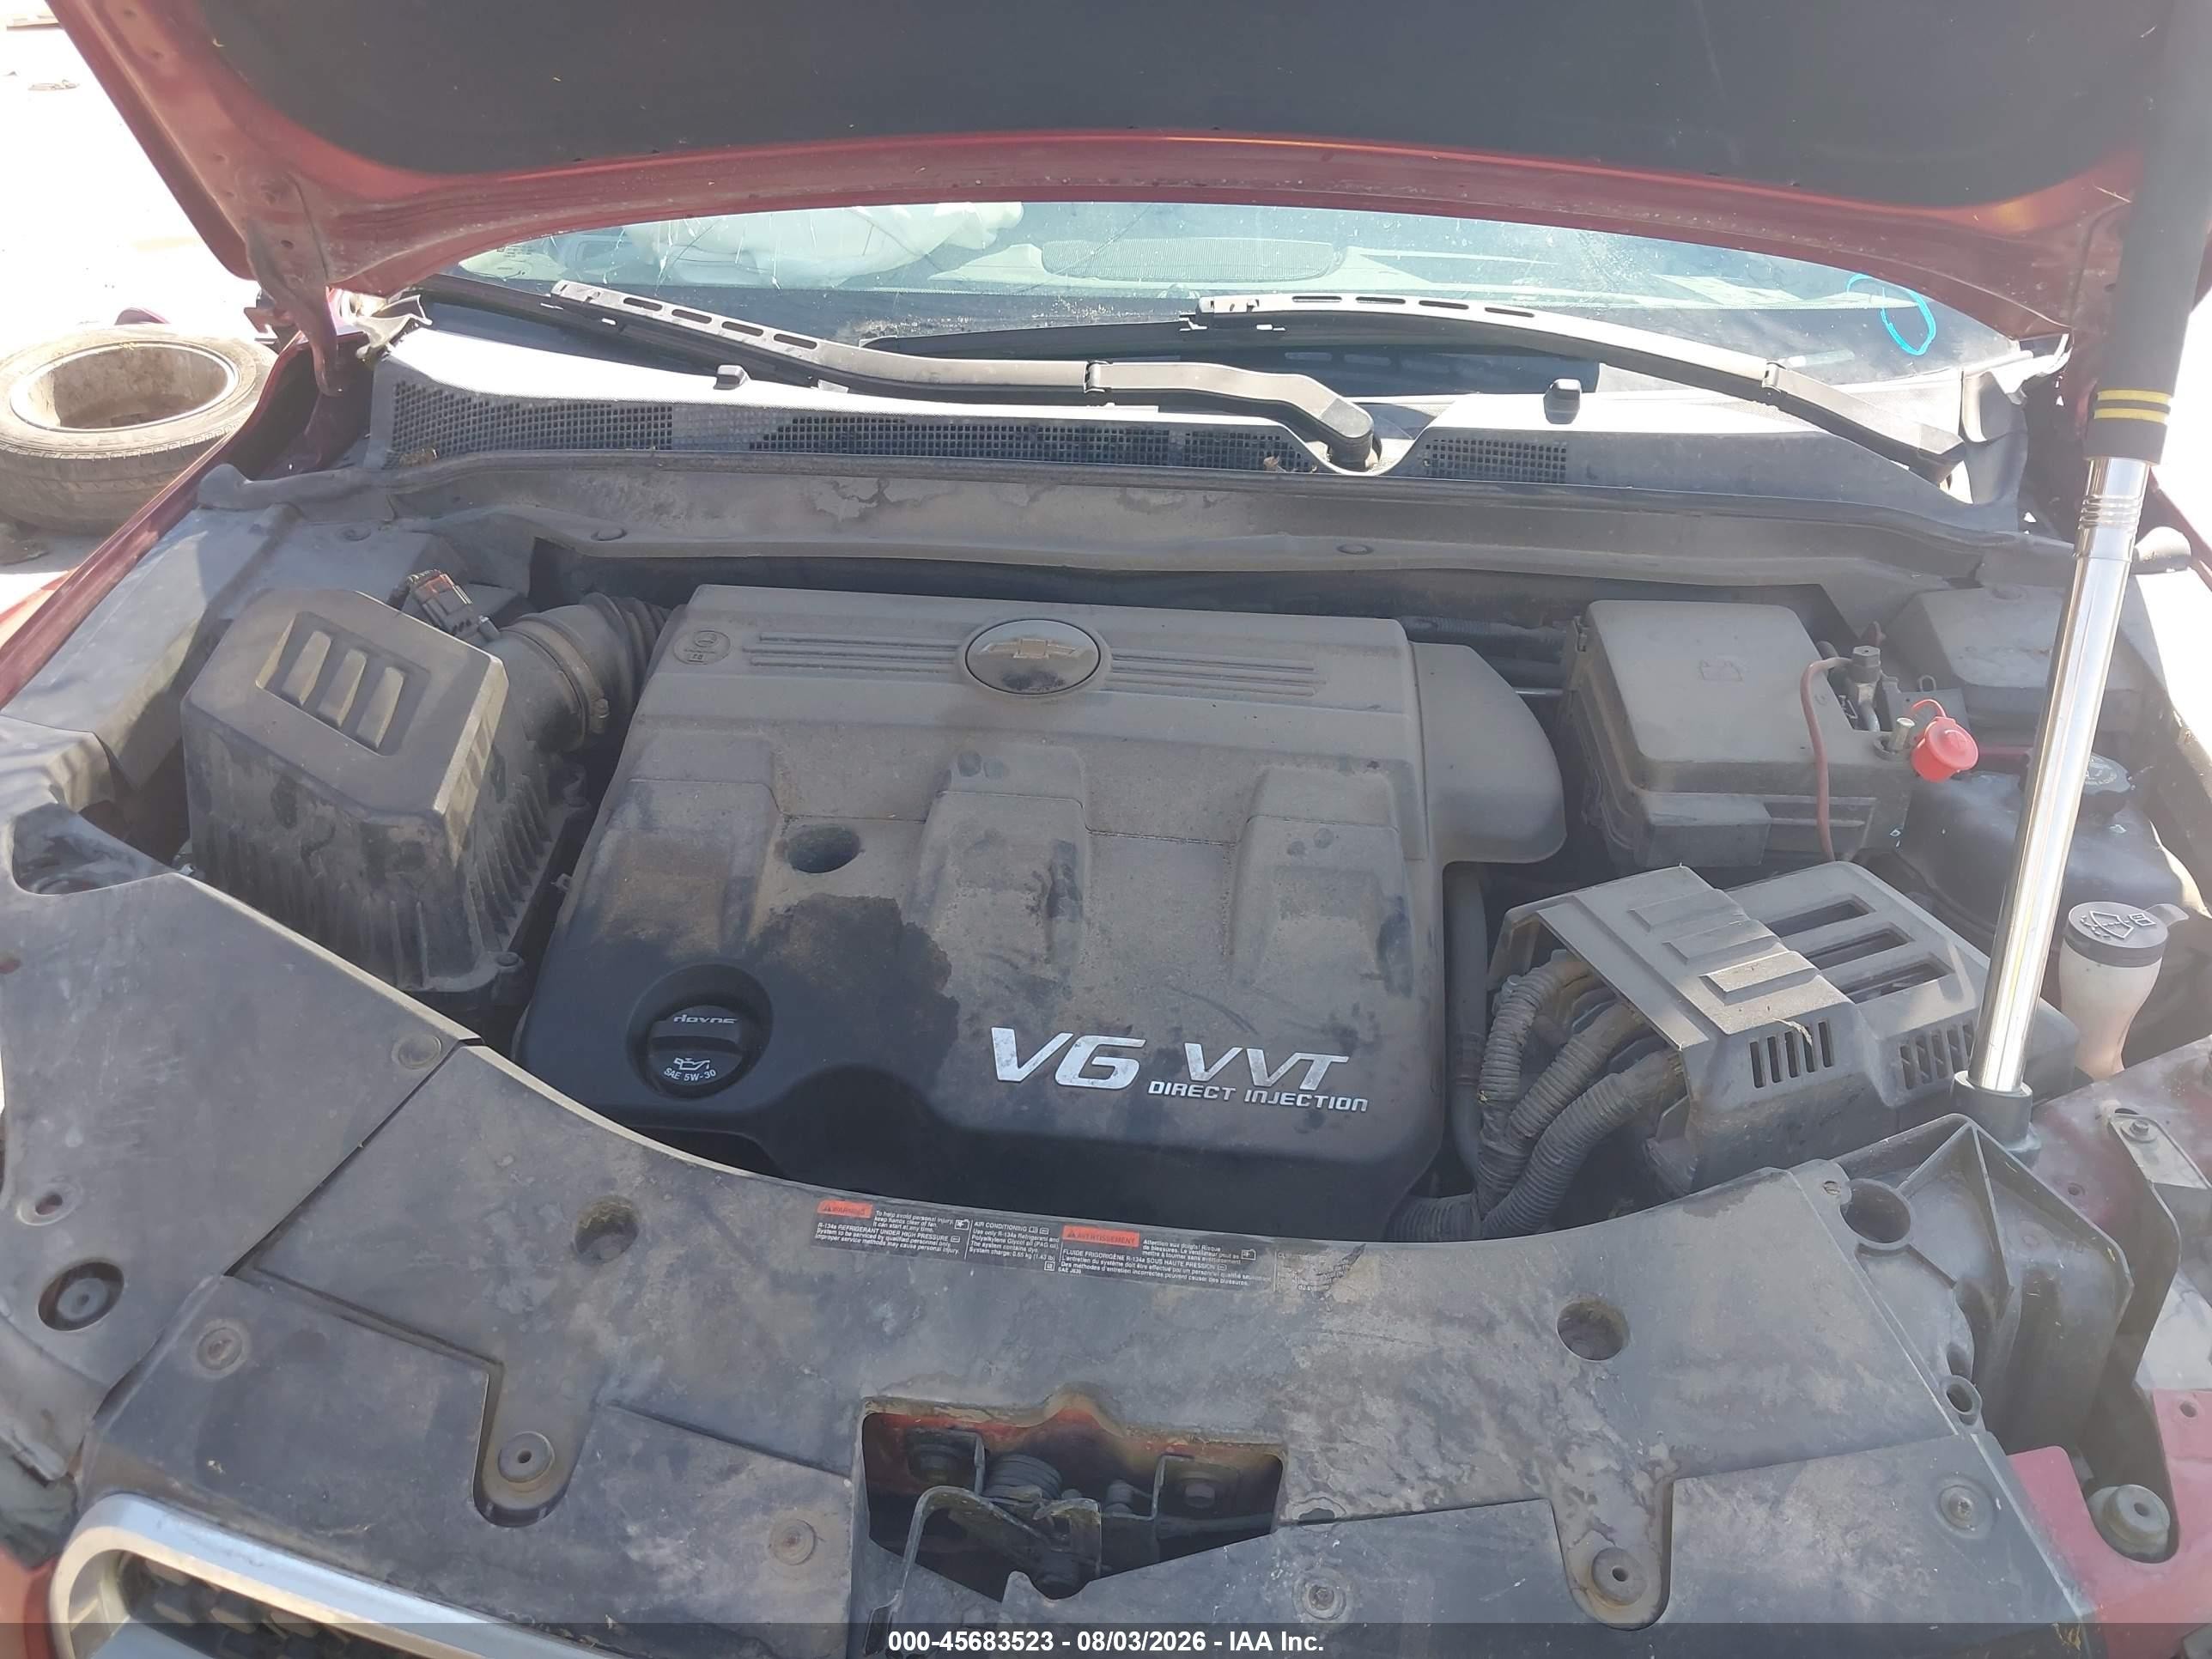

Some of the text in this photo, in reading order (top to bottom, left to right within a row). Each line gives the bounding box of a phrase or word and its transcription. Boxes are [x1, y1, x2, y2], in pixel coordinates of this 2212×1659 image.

[990, 1027, 1350, 1091] V6 VVT
[664, 1067, 716, 1081] SAE 5W-30
[1147, 1081, 1369, 1112] DIRECT INJECTION
[912, 1214, 936, 1223] personal
[985, 1222, 1027, 1232] CONDITIONING
[837, 1223, 878, 1234] REFRIGERANT
[916, 1232, 948, 1242] PRESSURE
[971, 1234, 1006, 1243] Polyalkylene
[1017, 1233, 1048, 1243] Refrigerant
[916, 1243, 941, 1253] personal
[969, 1246, 989, 1255] System
